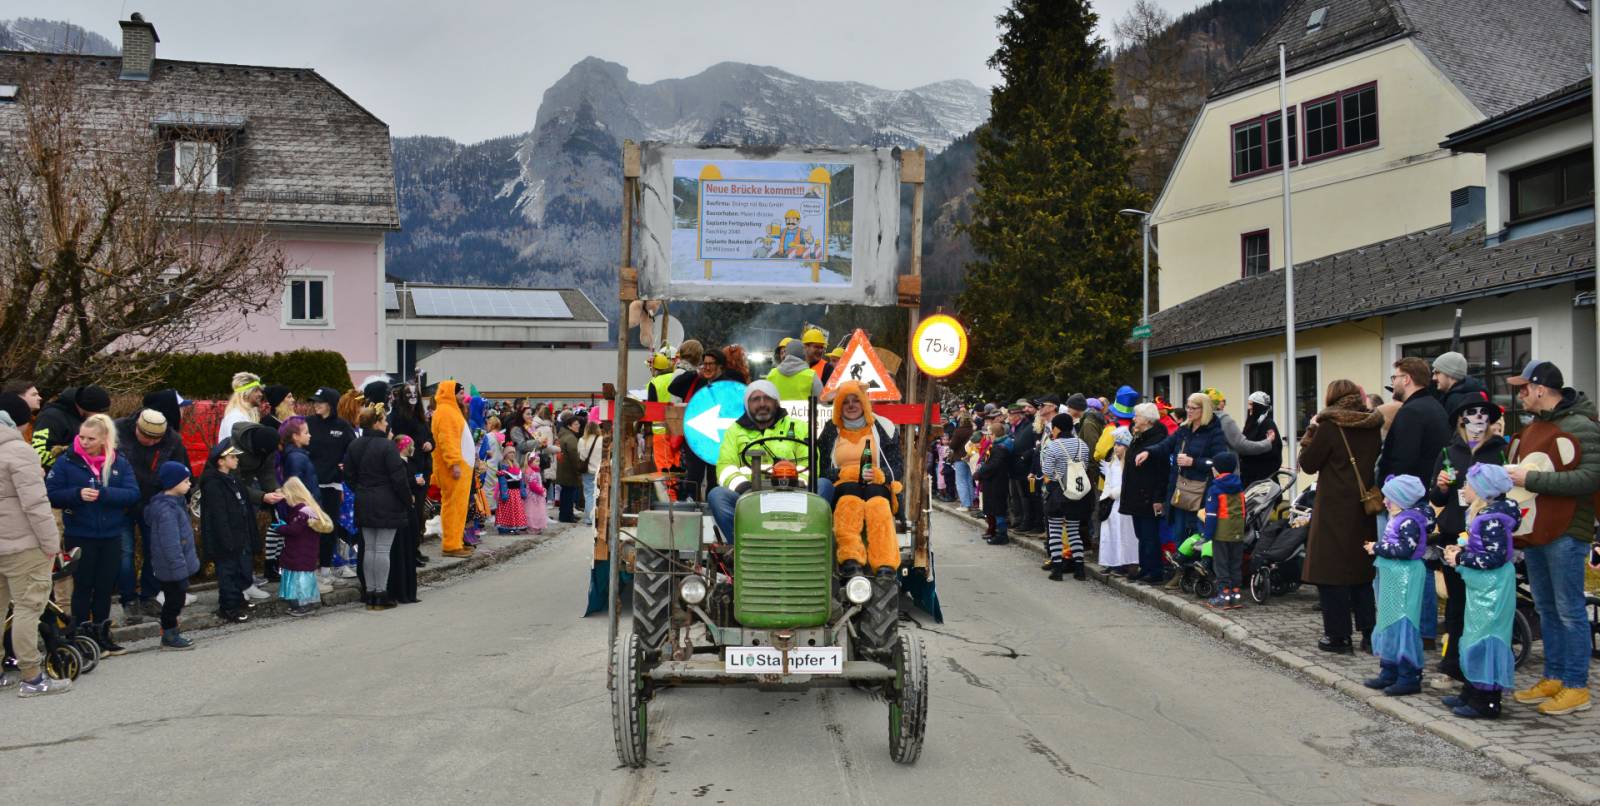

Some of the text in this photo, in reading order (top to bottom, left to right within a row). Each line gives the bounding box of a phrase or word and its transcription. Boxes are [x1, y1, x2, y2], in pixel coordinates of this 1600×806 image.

[706, 183, 805, 196] Neue Brücke kommt!!!
[925, 338, 955, 356] 75 kg
[791, 406, 833, 419] Achng
[730, 654, 744, 666] LI
[831, 654, 838, 666] 1
